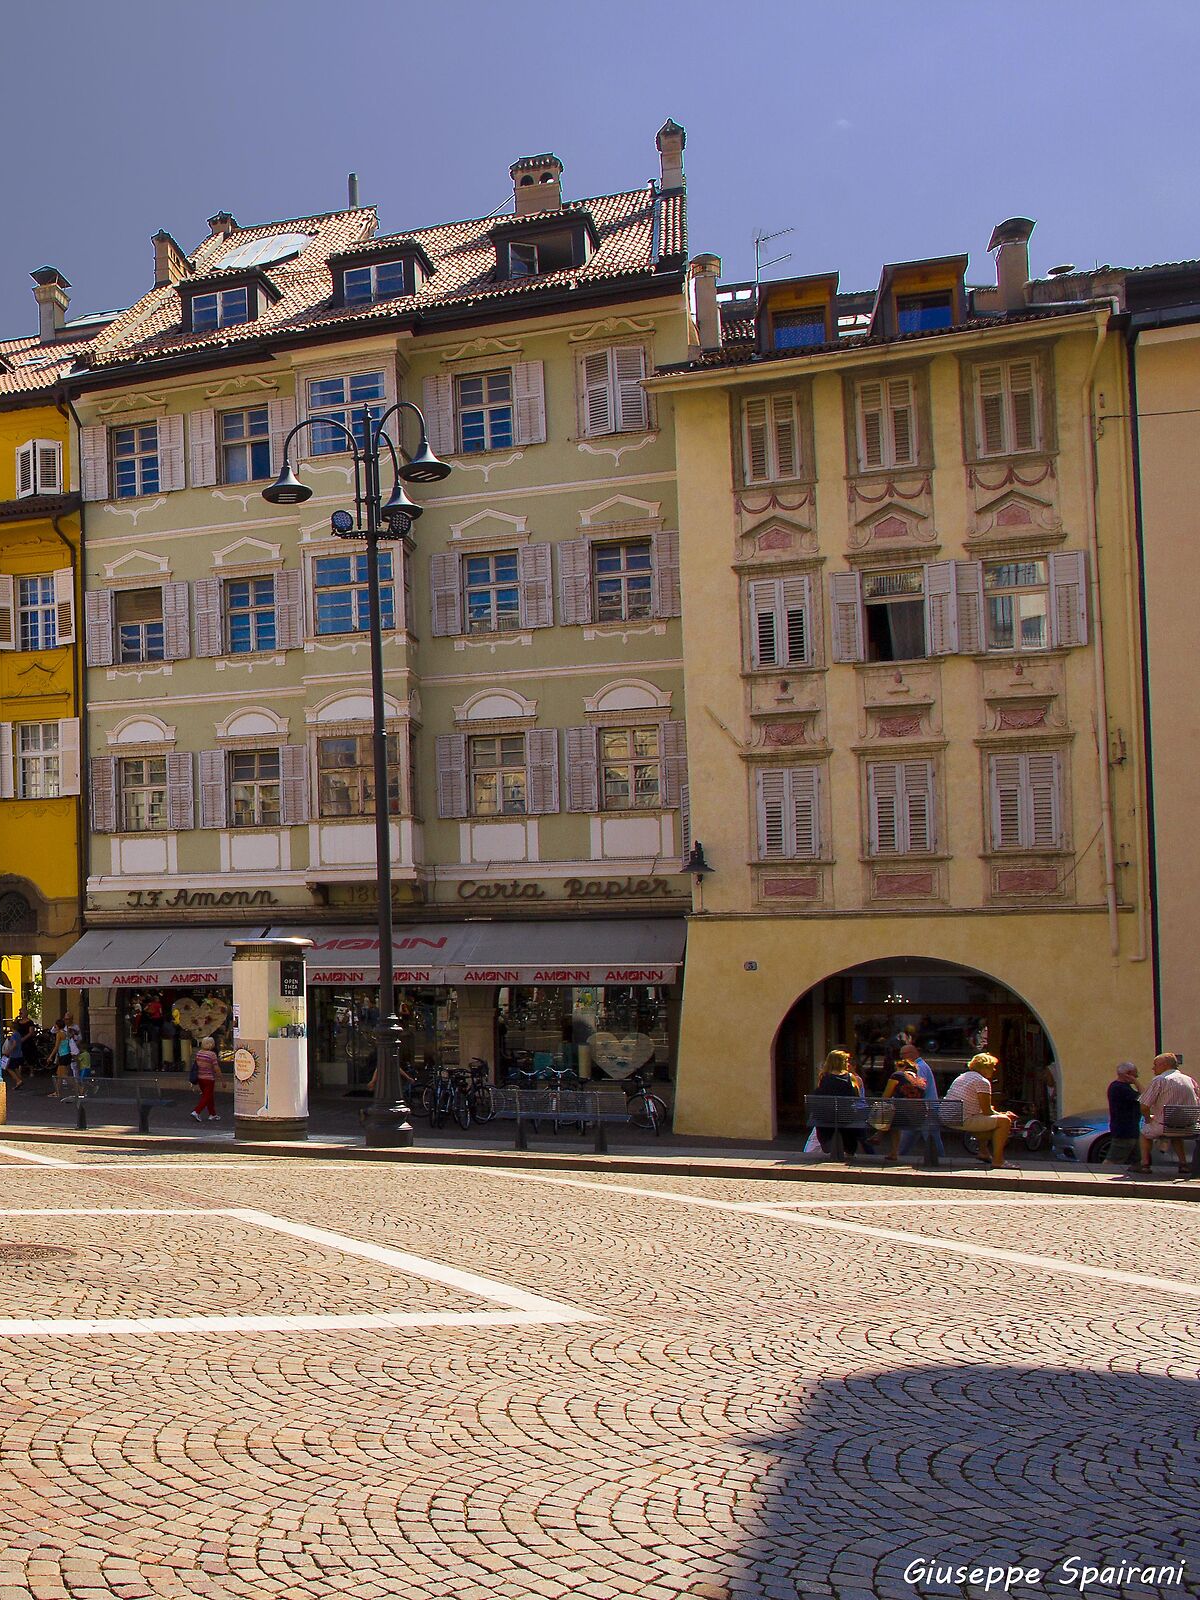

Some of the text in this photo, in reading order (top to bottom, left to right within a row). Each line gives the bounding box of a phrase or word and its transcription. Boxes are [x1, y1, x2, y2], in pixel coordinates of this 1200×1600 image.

[457, 877, 672, 899] Carta Papier
[166, 889, 279, 906] Amonn
[302, 936, 448, 950] MONN
[55, 976, 100, 986] AMONN
[112, 975, 158, 985] AMONN
[170, 973, 218, 983] AMONN
[312, 972, 364, 982] AMONN
[377, 971, 430, 982] MONN
[464, 971, 519, 982] AMONN
[533, 970, 590, 981] AMONN
[605, 970, 664, 981] AMONN
